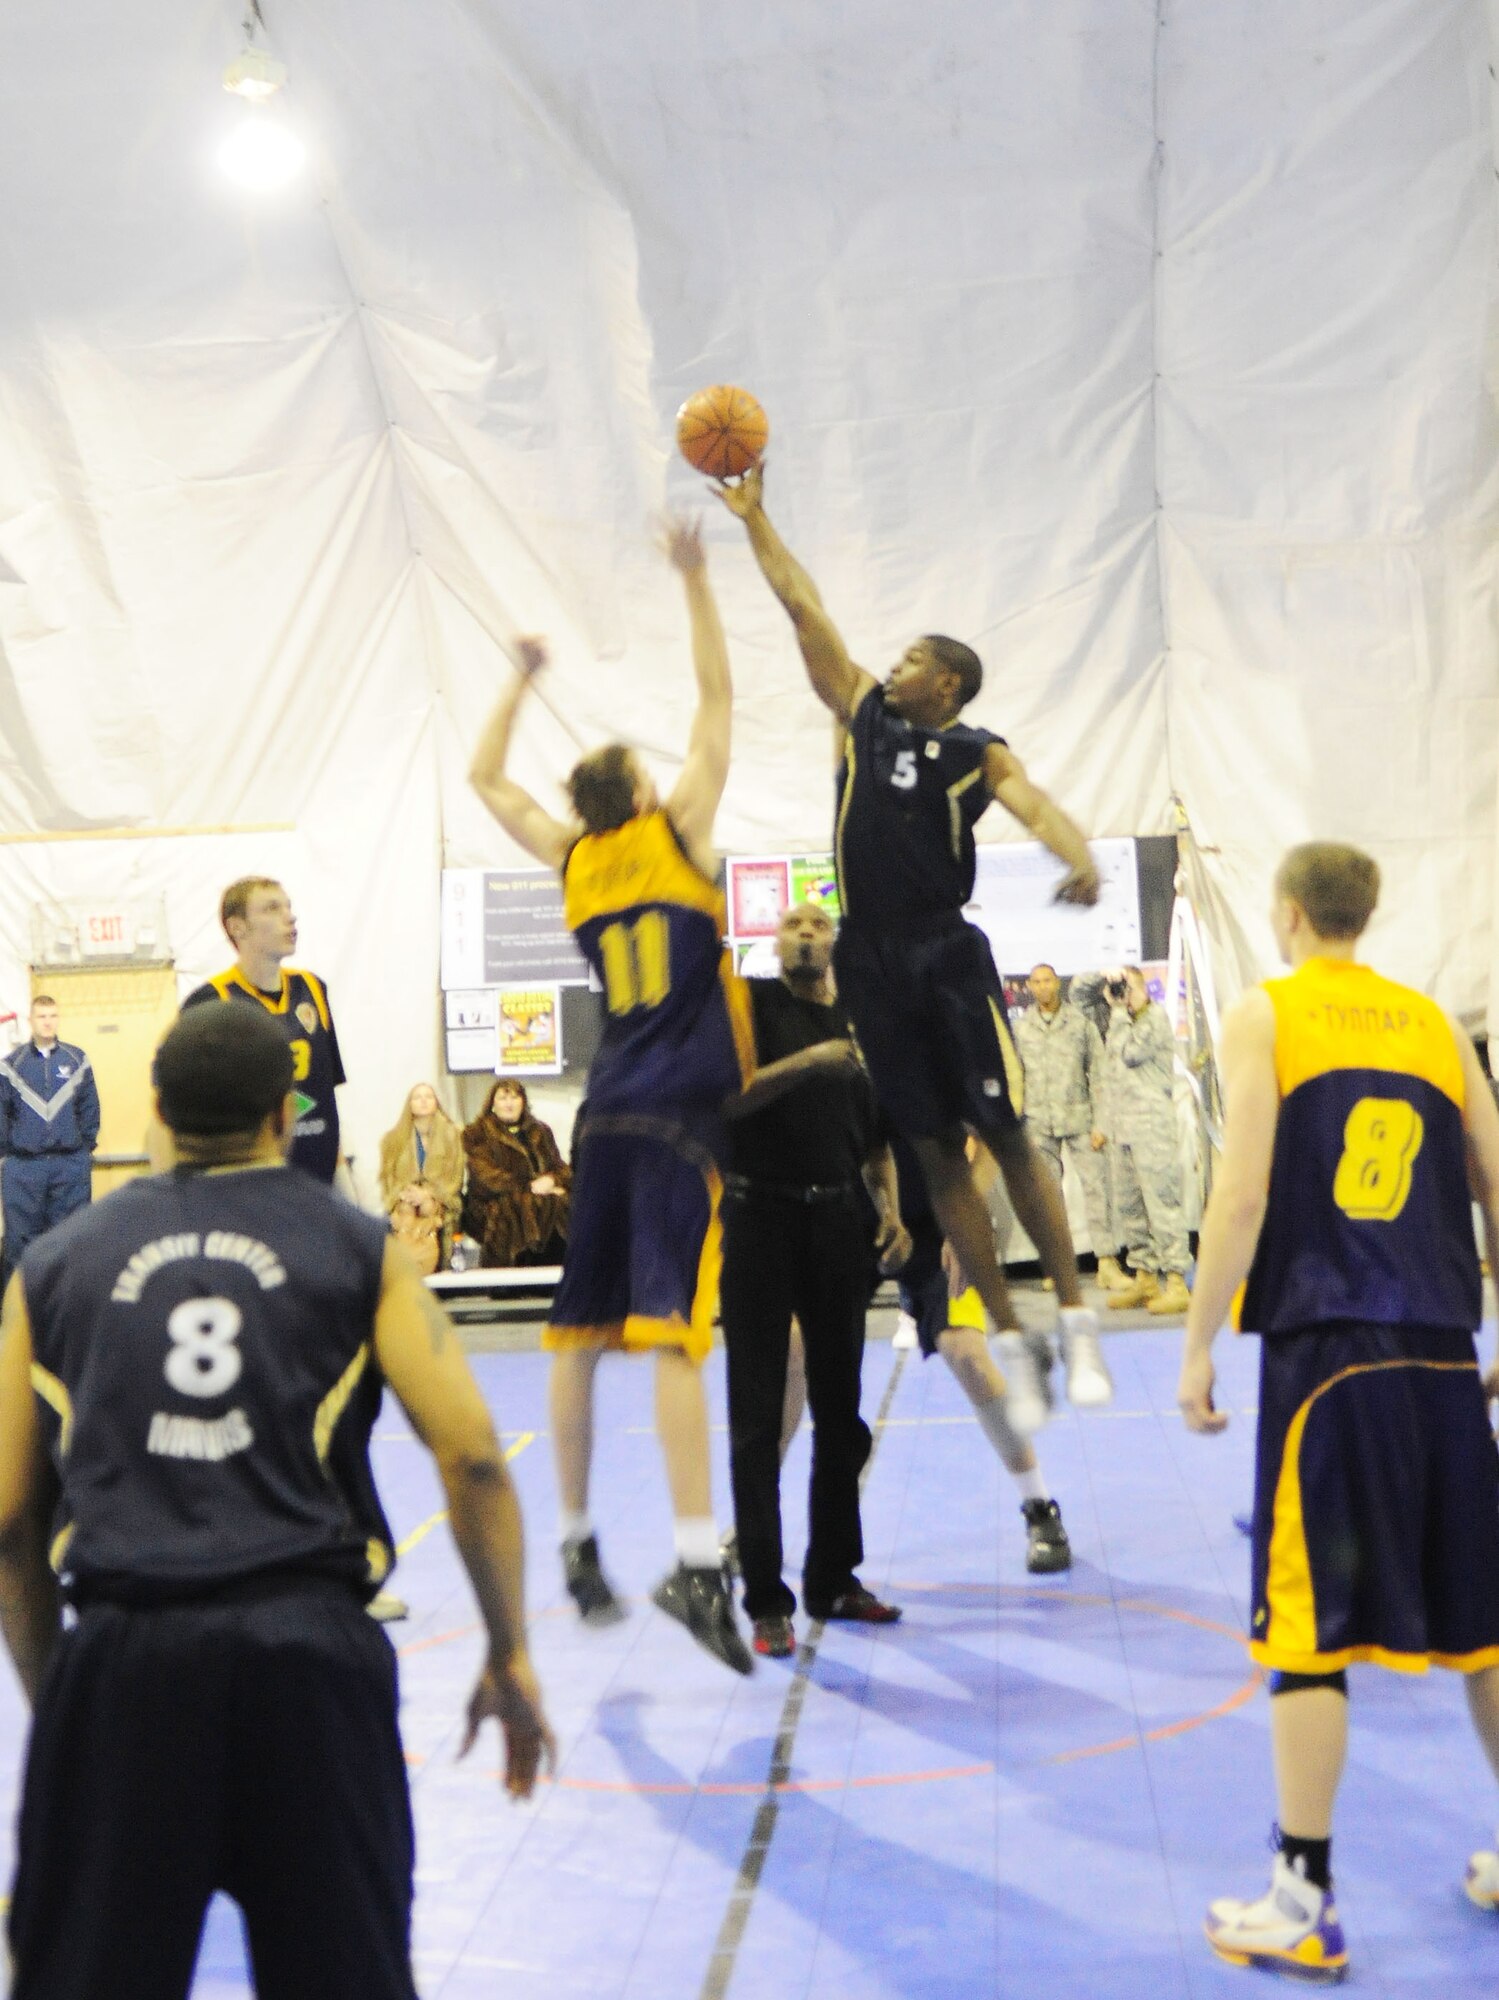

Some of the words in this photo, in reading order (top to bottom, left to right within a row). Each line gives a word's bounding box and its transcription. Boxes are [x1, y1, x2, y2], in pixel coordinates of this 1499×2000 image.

[890, 750, 918, 790] 5
[89, 916, 123, 943] EXIT
[597, 909, 671, 1018] 11
[1333, 1096, 1425, 1222] 8
[164, 1296, 243, 1399] 8
